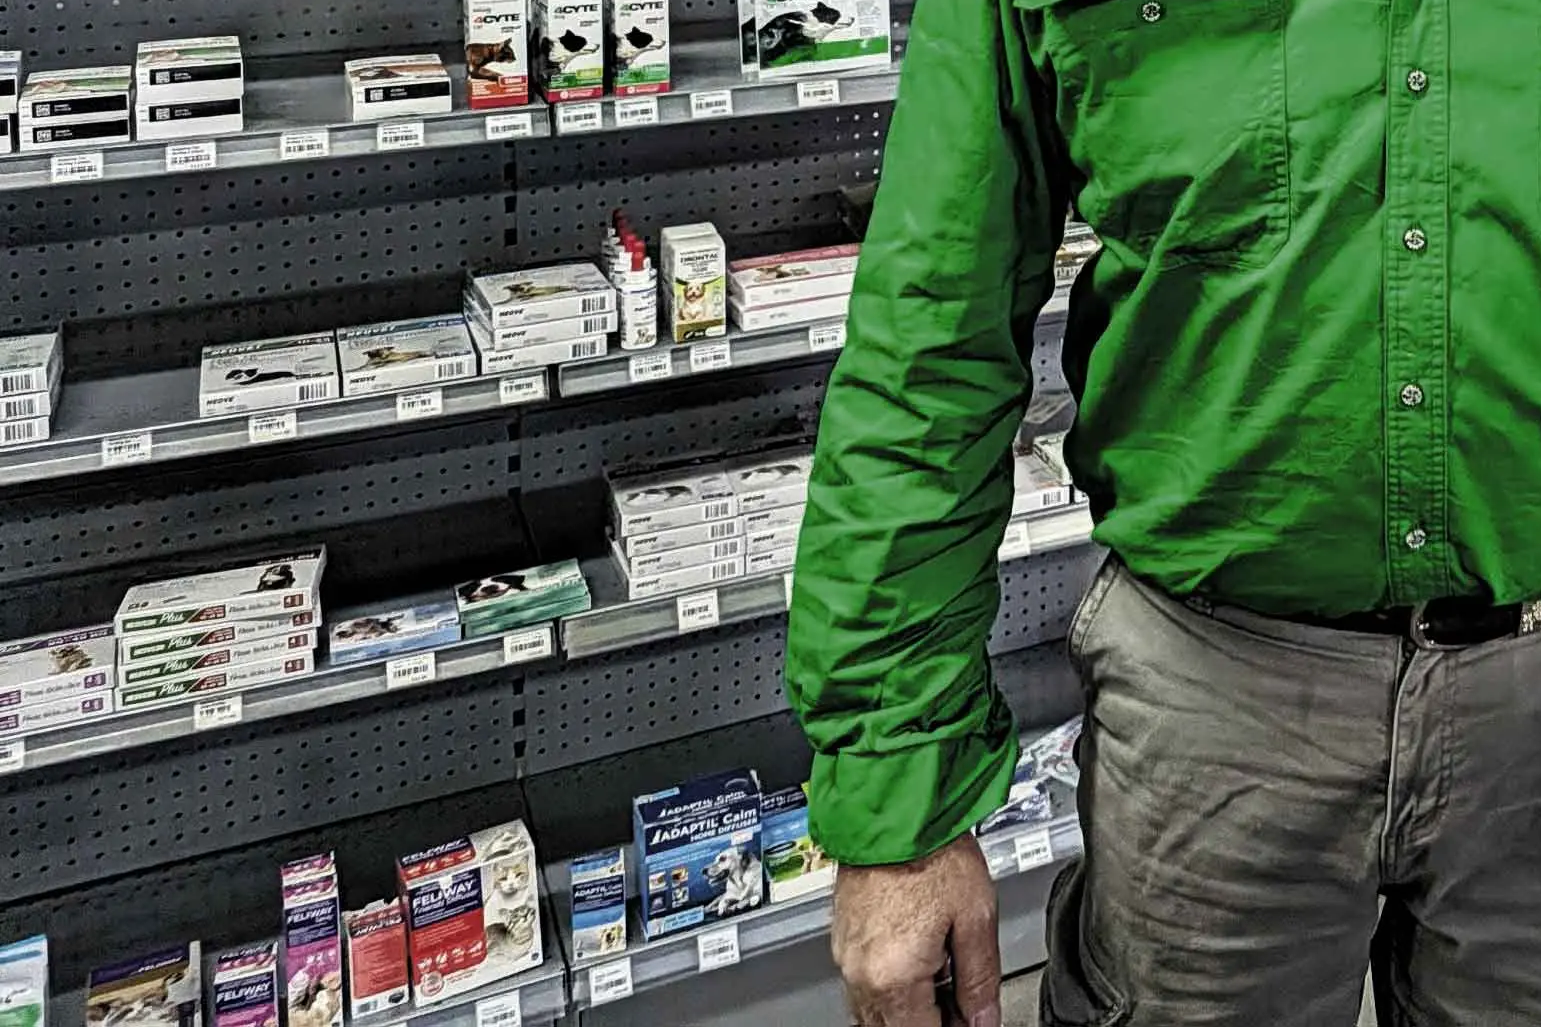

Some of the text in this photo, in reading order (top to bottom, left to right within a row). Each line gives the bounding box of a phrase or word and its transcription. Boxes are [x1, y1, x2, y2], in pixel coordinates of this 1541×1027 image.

[554, 3, 600, 14] 4CYTE
[621, 1, 664, 12] 4CYTE
[473, 13, 520, 24] 4CYTE
[161, 612, 185, 624] Plus
[168, 637, 193, 649] Plus
[164, 660, 190, 673] Plus
[160, 683, 186, 696] Plus
[652, 808, 757, 845] ADAPTIL Calm
